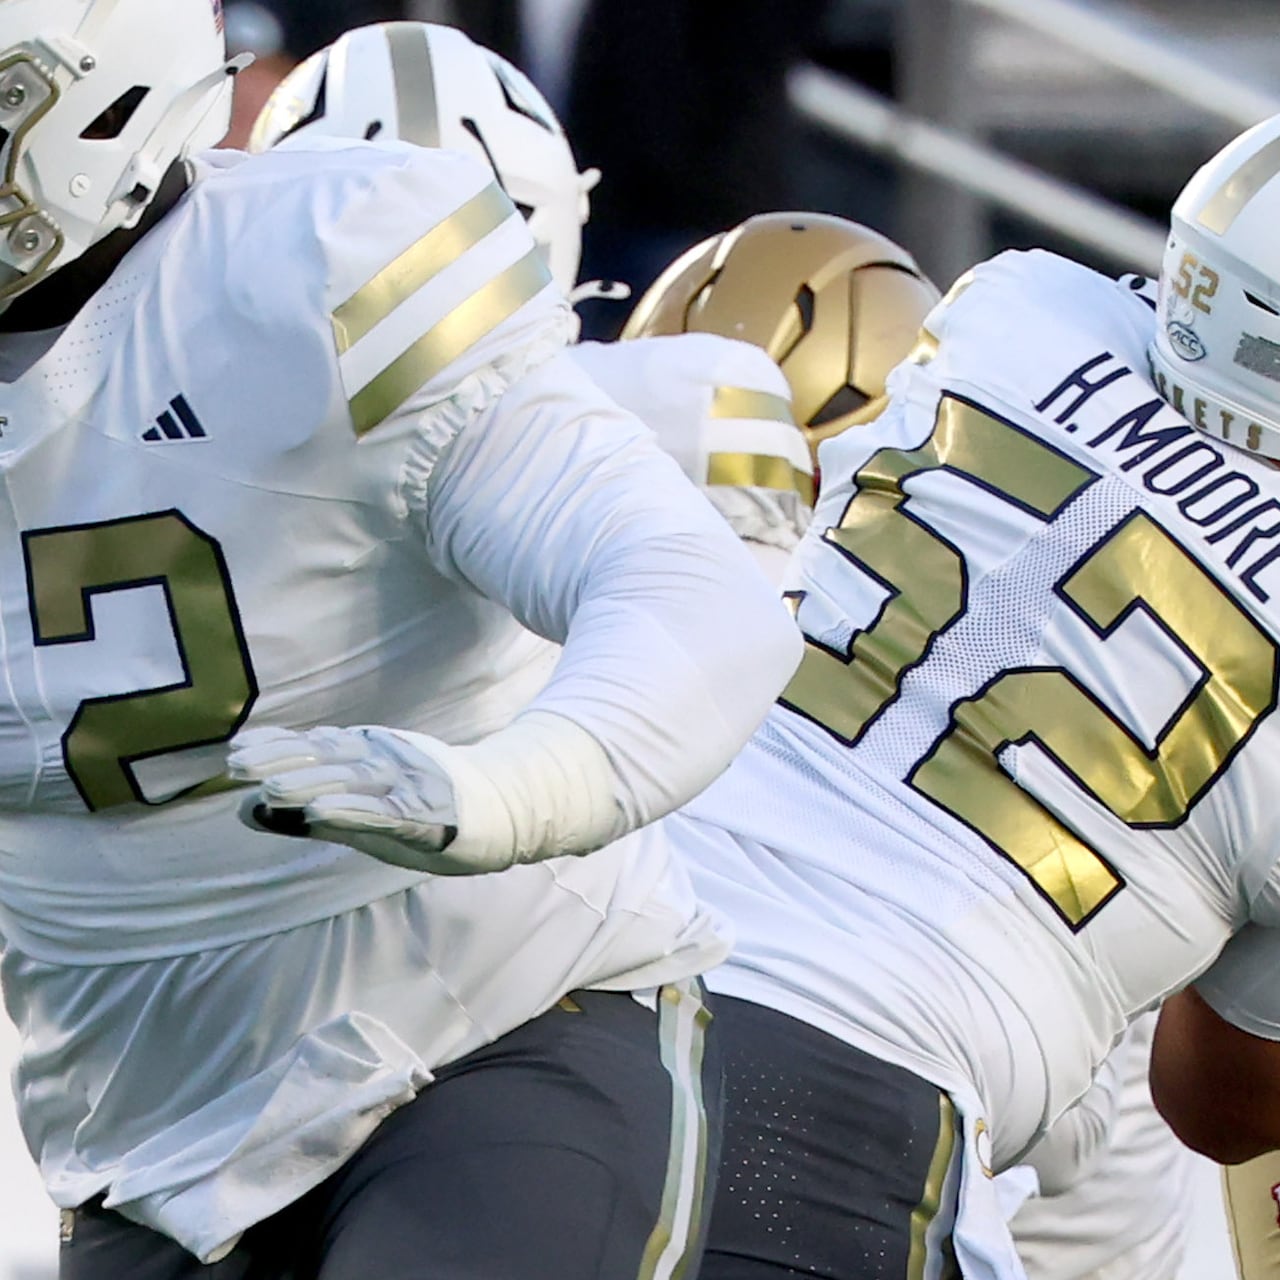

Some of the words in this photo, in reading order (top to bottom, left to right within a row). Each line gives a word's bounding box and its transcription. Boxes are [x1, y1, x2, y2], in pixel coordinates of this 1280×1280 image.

[1173, 253, 1219, 316] 52
[1034, 350, 1133, 434] H.
[21, 508, 259, 812] 2
